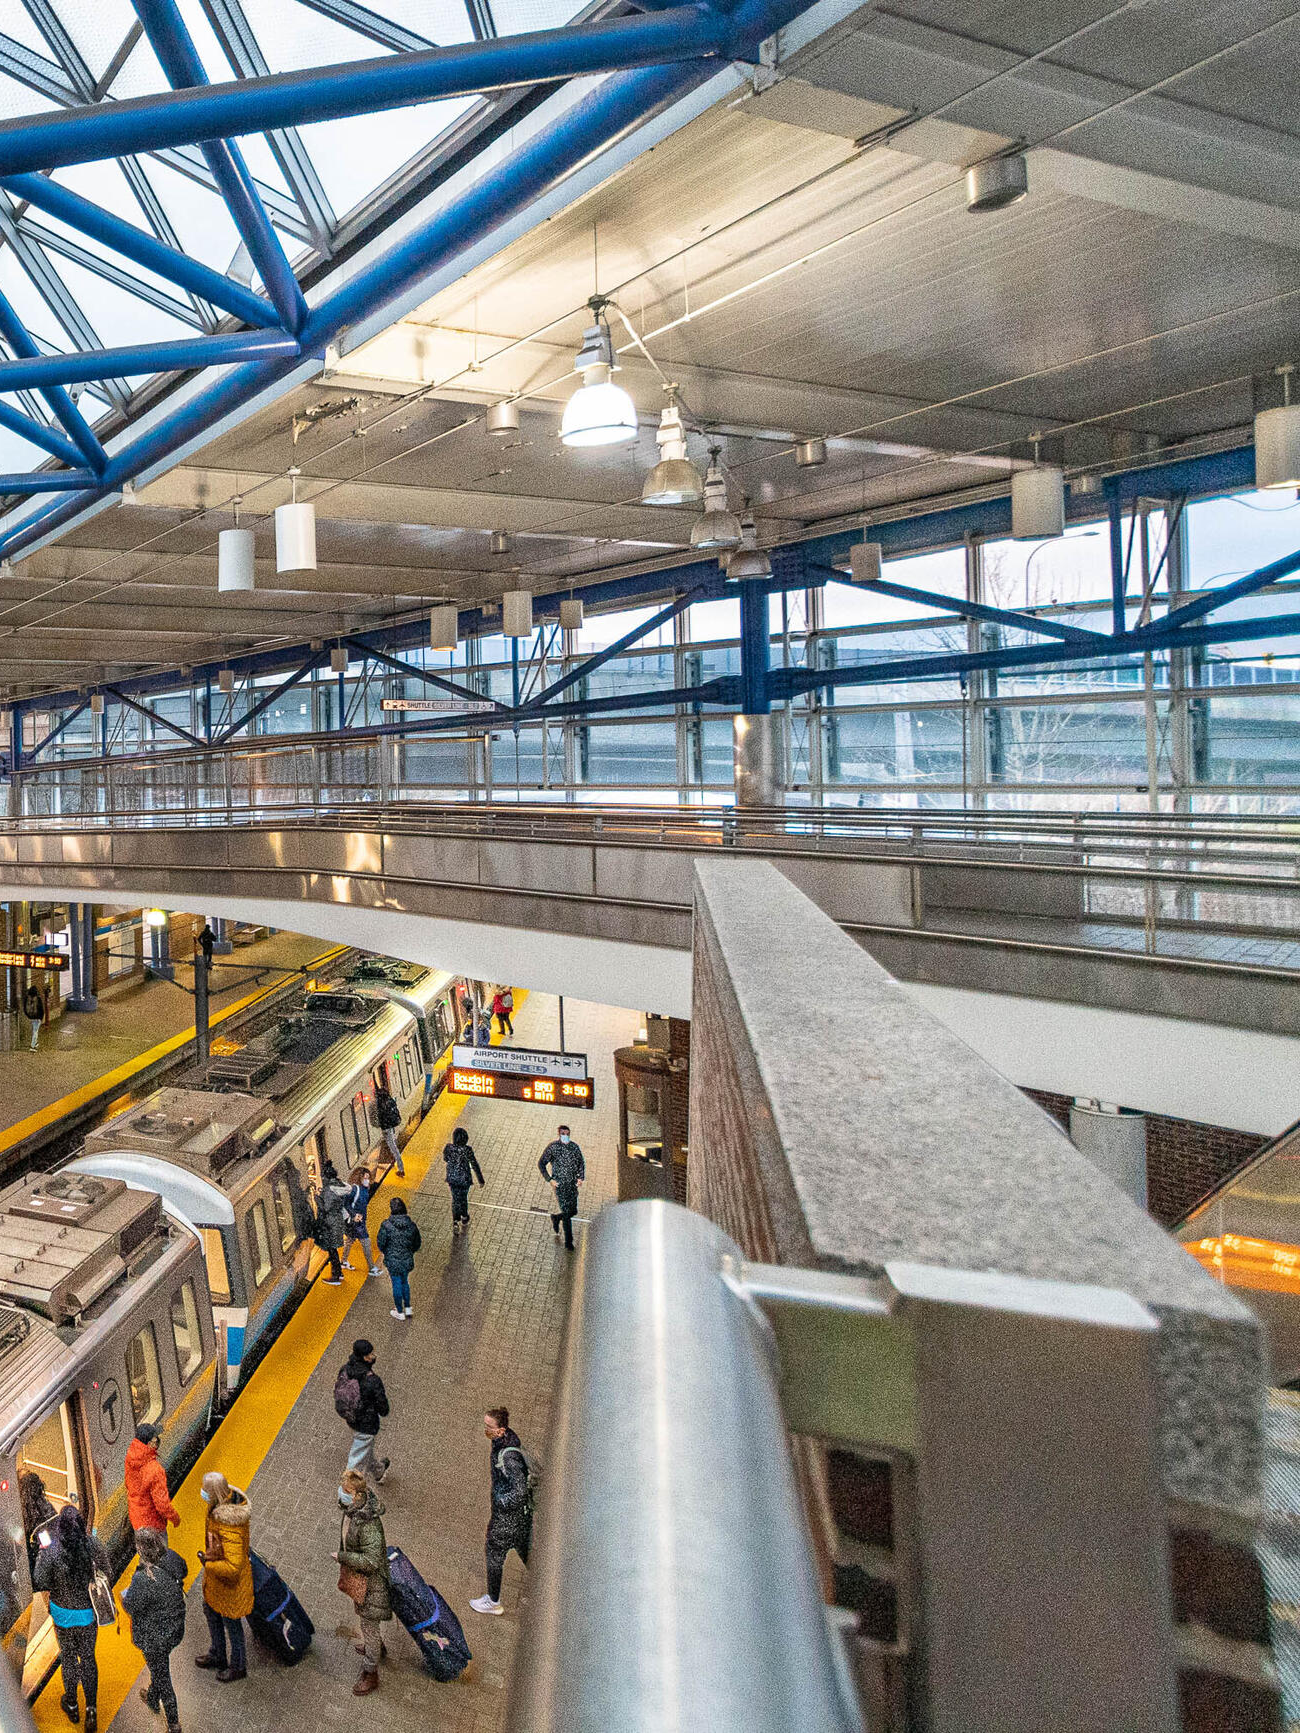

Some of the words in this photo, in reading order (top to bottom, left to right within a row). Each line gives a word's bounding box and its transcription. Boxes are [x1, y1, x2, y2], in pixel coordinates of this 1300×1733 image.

[473, 1050, 509, 1060] AIRPORT
[510, 1053, 548, 1064] SHUTTLE
[474, 1060, 502, 1069] SILVER
[503, 1062, 521, 1071] LINE
[454, 1072, 493, 1086] Bowdoin
[534, 1081, 554, 1092] BRD
[562, 1084, 588, 1097] 3:50
[454, 1081, 493, 1095] Bowdoin
[523, 1088, 531, 1099] 5
[534, 1090, 554, 1102] min
[103, 1389, 118, 1433] T
